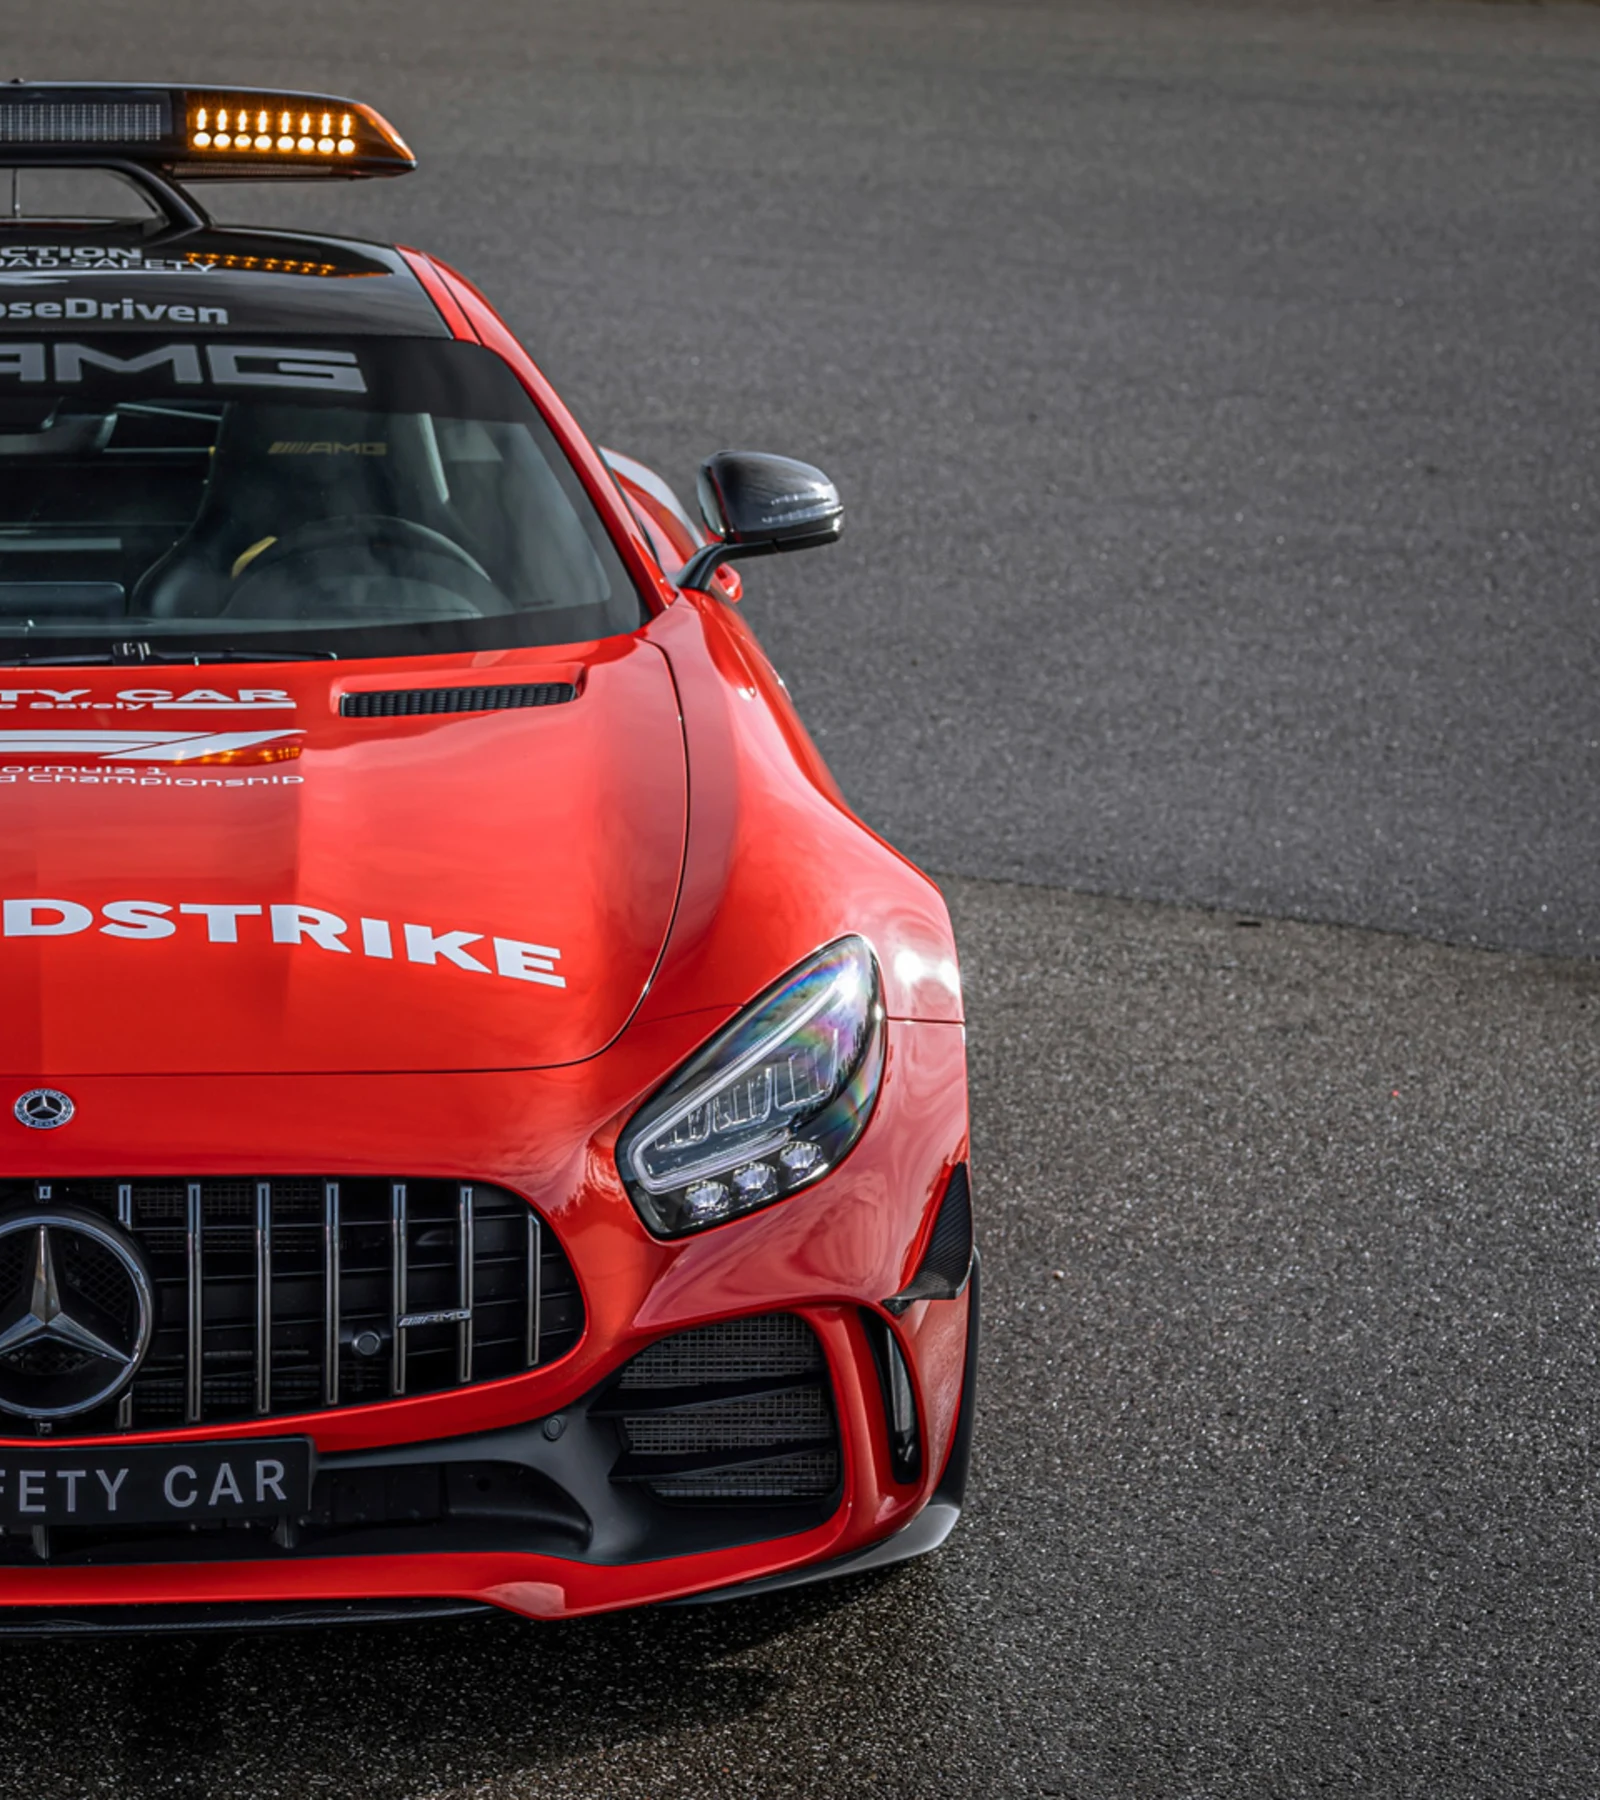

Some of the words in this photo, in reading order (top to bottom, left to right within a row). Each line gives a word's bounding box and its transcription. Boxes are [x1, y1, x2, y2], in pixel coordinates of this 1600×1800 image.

[71, 257, 217, 272] SAFETY
[306, 441, 387, 456] AMG
[116, 689, 295, 702] CAR
[29, 701, 147, 711] Safely
[147, 767, 167, 776] 1
[28, 773, 305, 787] Championship
[162, 1459, 288, 1507] CAR
